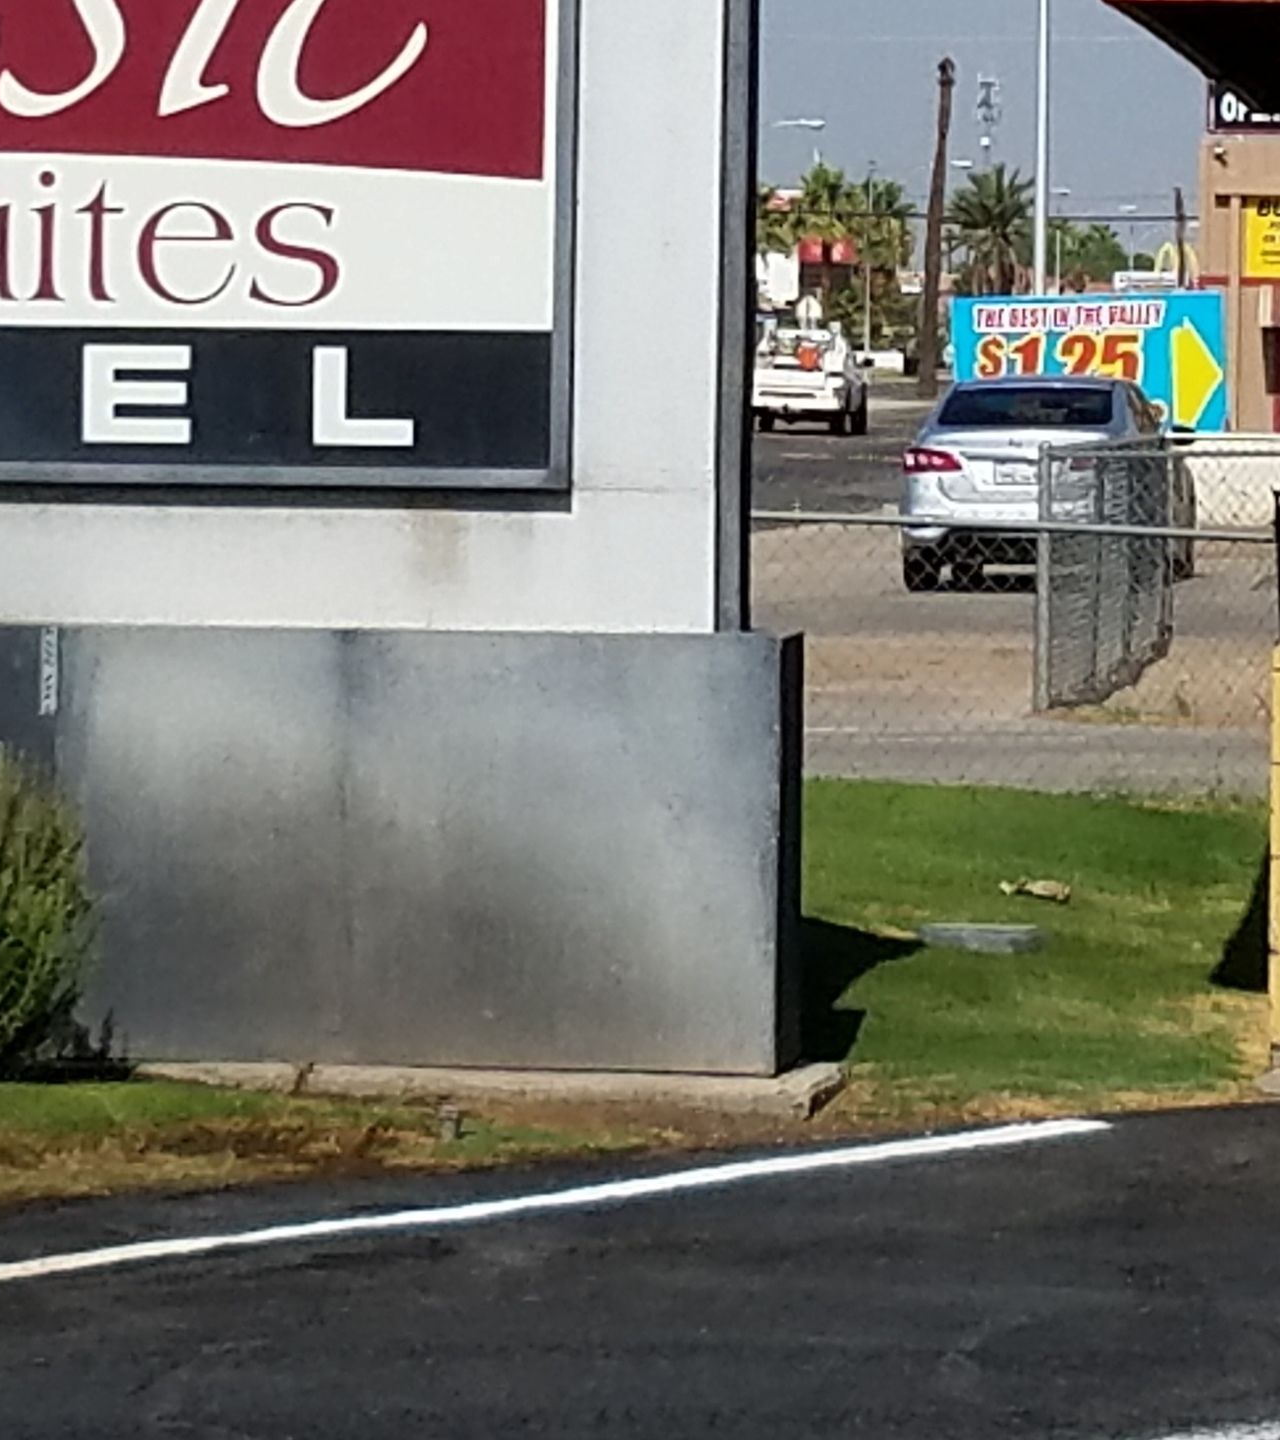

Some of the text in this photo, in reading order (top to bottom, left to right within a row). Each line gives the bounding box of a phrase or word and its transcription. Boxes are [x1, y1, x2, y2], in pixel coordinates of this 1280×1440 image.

[976, 302, 1163, 329] THE BEST IN THE VALLEY
[977, 334, 1140, 380] $125
